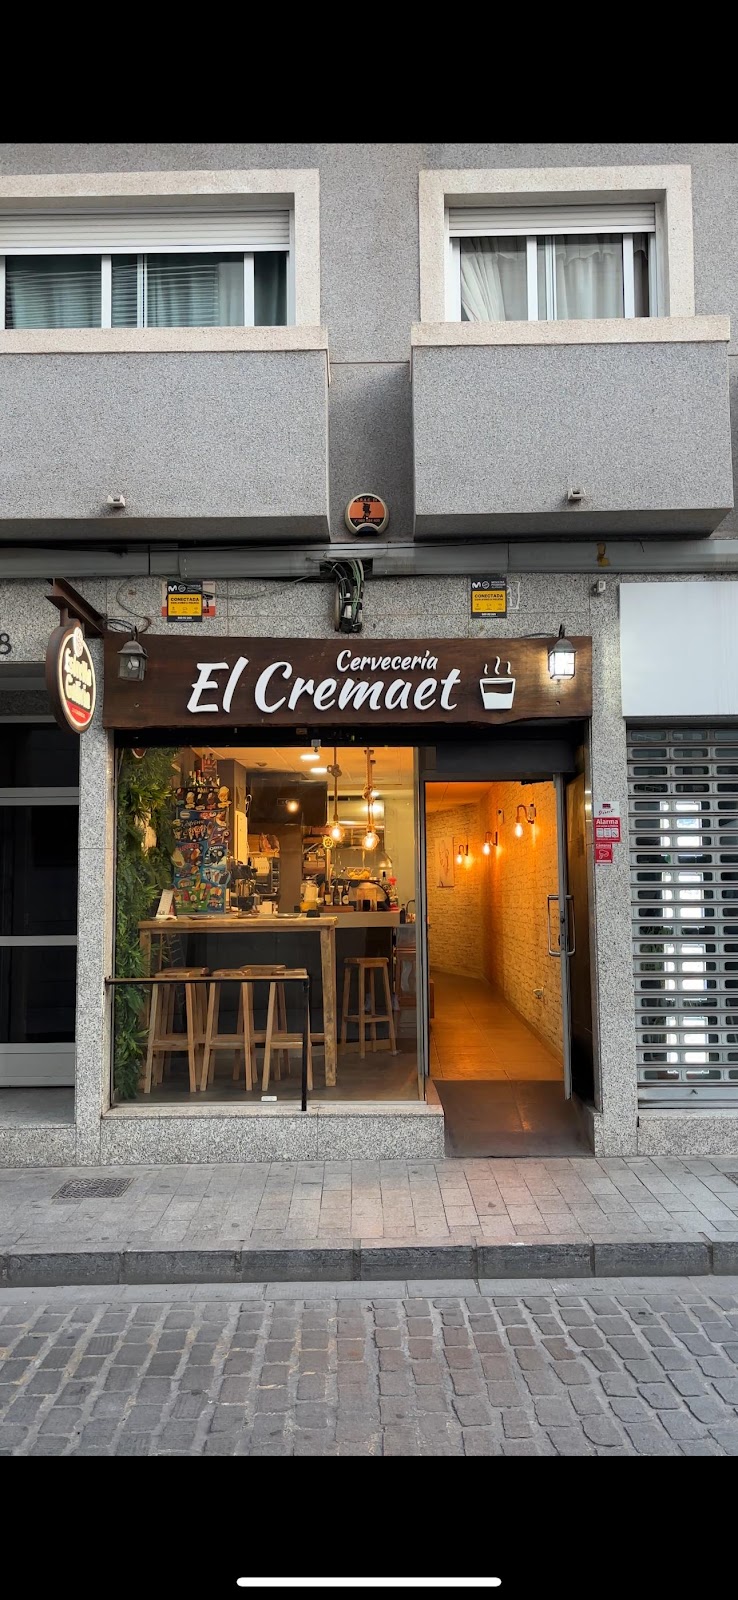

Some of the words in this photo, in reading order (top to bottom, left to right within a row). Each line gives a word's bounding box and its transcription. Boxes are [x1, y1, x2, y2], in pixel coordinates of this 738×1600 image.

[336, 649, 439, 672] Cervecería
[186, 656, 250, 713] El
[254, 661, 461, 713] Cremaet
